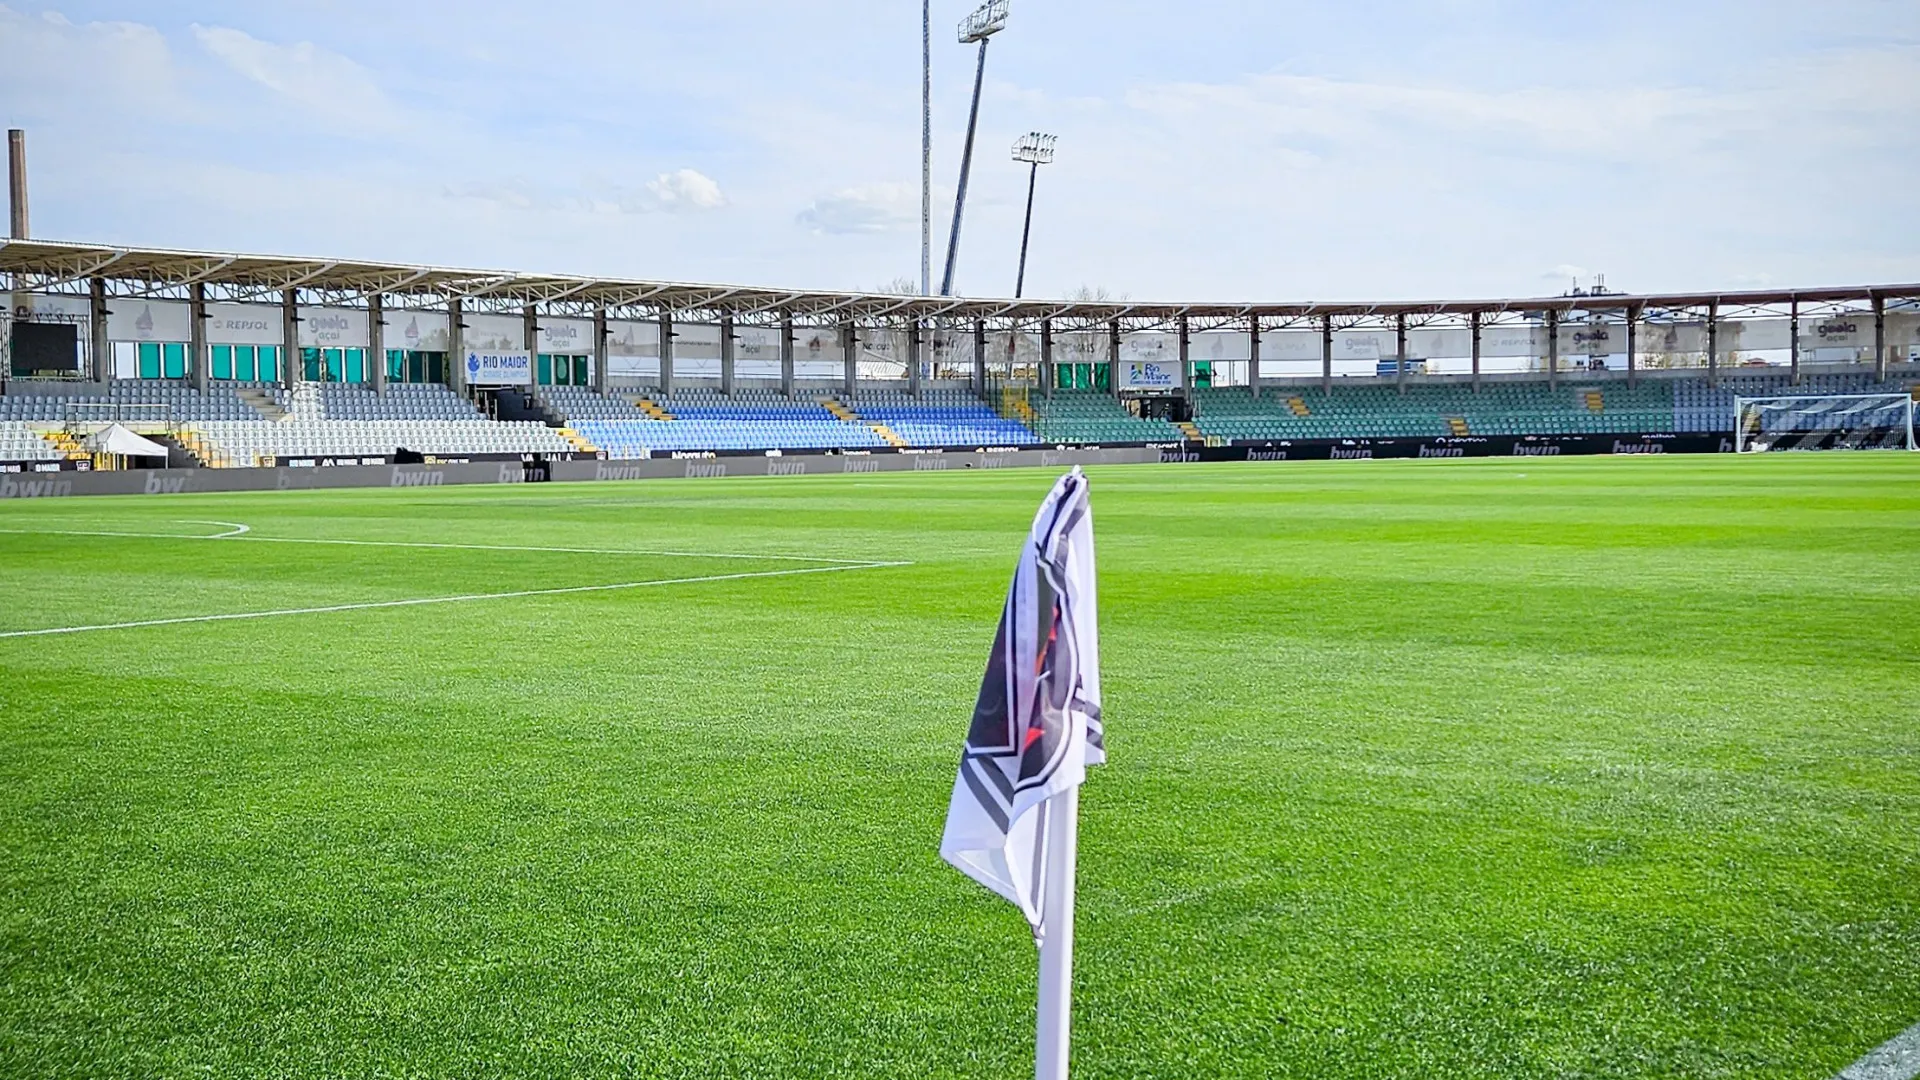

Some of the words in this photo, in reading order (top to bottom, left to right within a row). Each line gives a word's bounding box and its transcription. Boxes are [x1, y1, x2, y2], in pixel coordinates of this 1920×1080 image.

[226, 320, 268, 330] REPSOL
[483, 356, 498, 369] RIO
[500, 356, 528, 369] MAIOR
[1144, 363, 1160, 372] Rio
[1144, 371, 1171, 380] Maior
[1330, 445, 1372, 459] bwin
[1418, 444, 1463, 457] bwin
[1513, 442, 1560, 455] bwin
[1611, 440, 1664, 453] bwin
[1247, 447, 1287, 461] bwin
[595, 460, 641, 481] bwin
[685, 458, 727, 478] bwin
[767, 457, 805, 475] bwin
[843, 454, 879, 473] bwin
[390, 466, 444, 486] bwin
[0, 472, 72, 498] bwin
